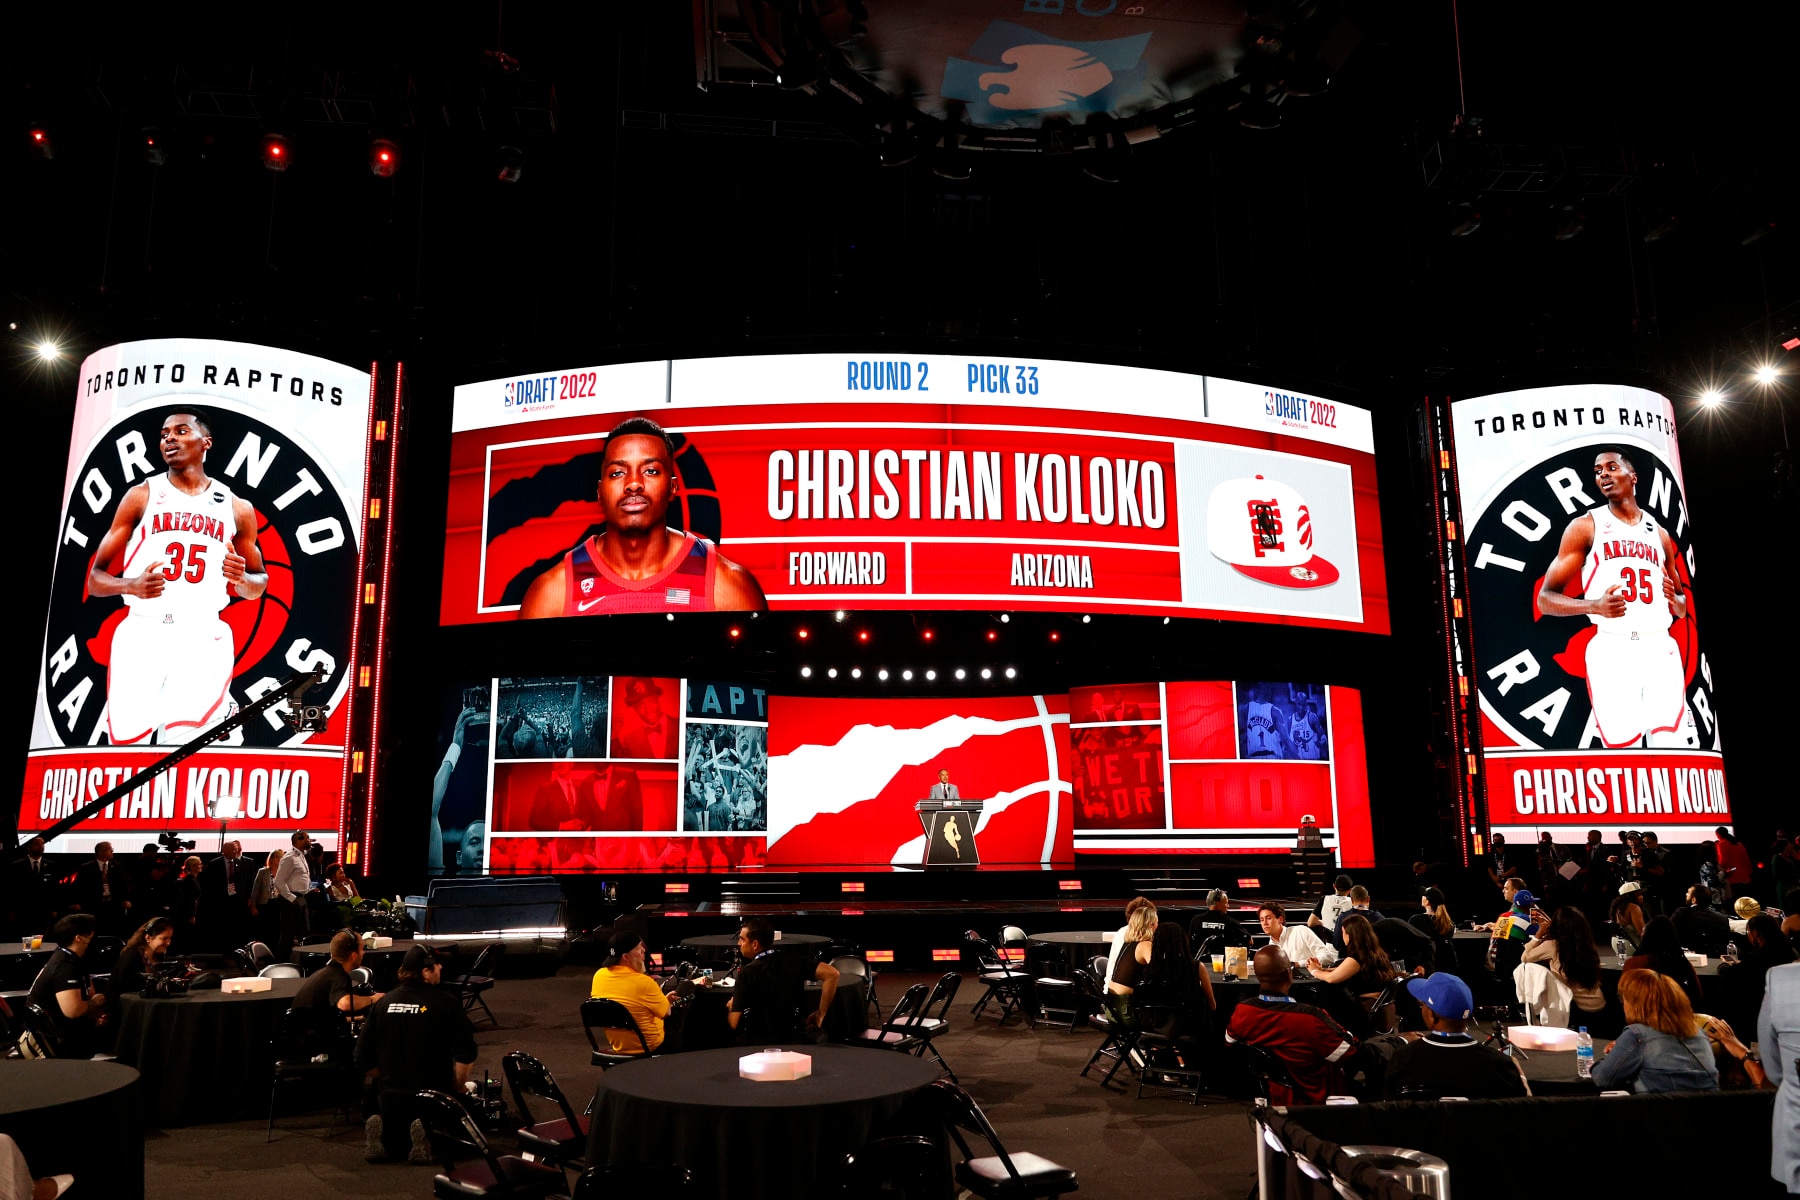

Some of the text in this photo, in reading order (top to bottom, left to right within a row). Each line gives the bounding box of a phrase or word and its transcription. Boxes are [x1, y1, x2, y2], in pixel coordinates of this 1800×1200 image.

[87, 363, 343, 406] TORONTO RAPTORS
[516, 372, 597, 406] DRAFT 2022
[847, 362, 929, 391] ROUND 2
[967, 363, 1039, 395] PICK 33
[1275, 393, 1337, 429] DRAFT 2022
[1475, 407, 1605, 437] TORONTO
[63, 429, 345, 556] TORNTO
[767, 448, 1167, 529] CHRISTIAN KOLOKO
[151, 511, 225, 543] ARIZONA
[1474, 466, 1696, 579] TORNTO
[162, 541, 208, 583] 35
[788, 551, 887, 587] FORWARD
[1010, 553, 1094, 589] ARIZONA
[1603, 539, 1660, 568] ARIZONA
[1620, 566, 1654, 604] 35
[1085, 754, 1122, 787] WE
[40, 767, 311, 820] CHRISTIAN KOLOKO
[1513, 768, 1673, 815] CHRISTIAN
[1201, 921, 1225, 930] ESPN
